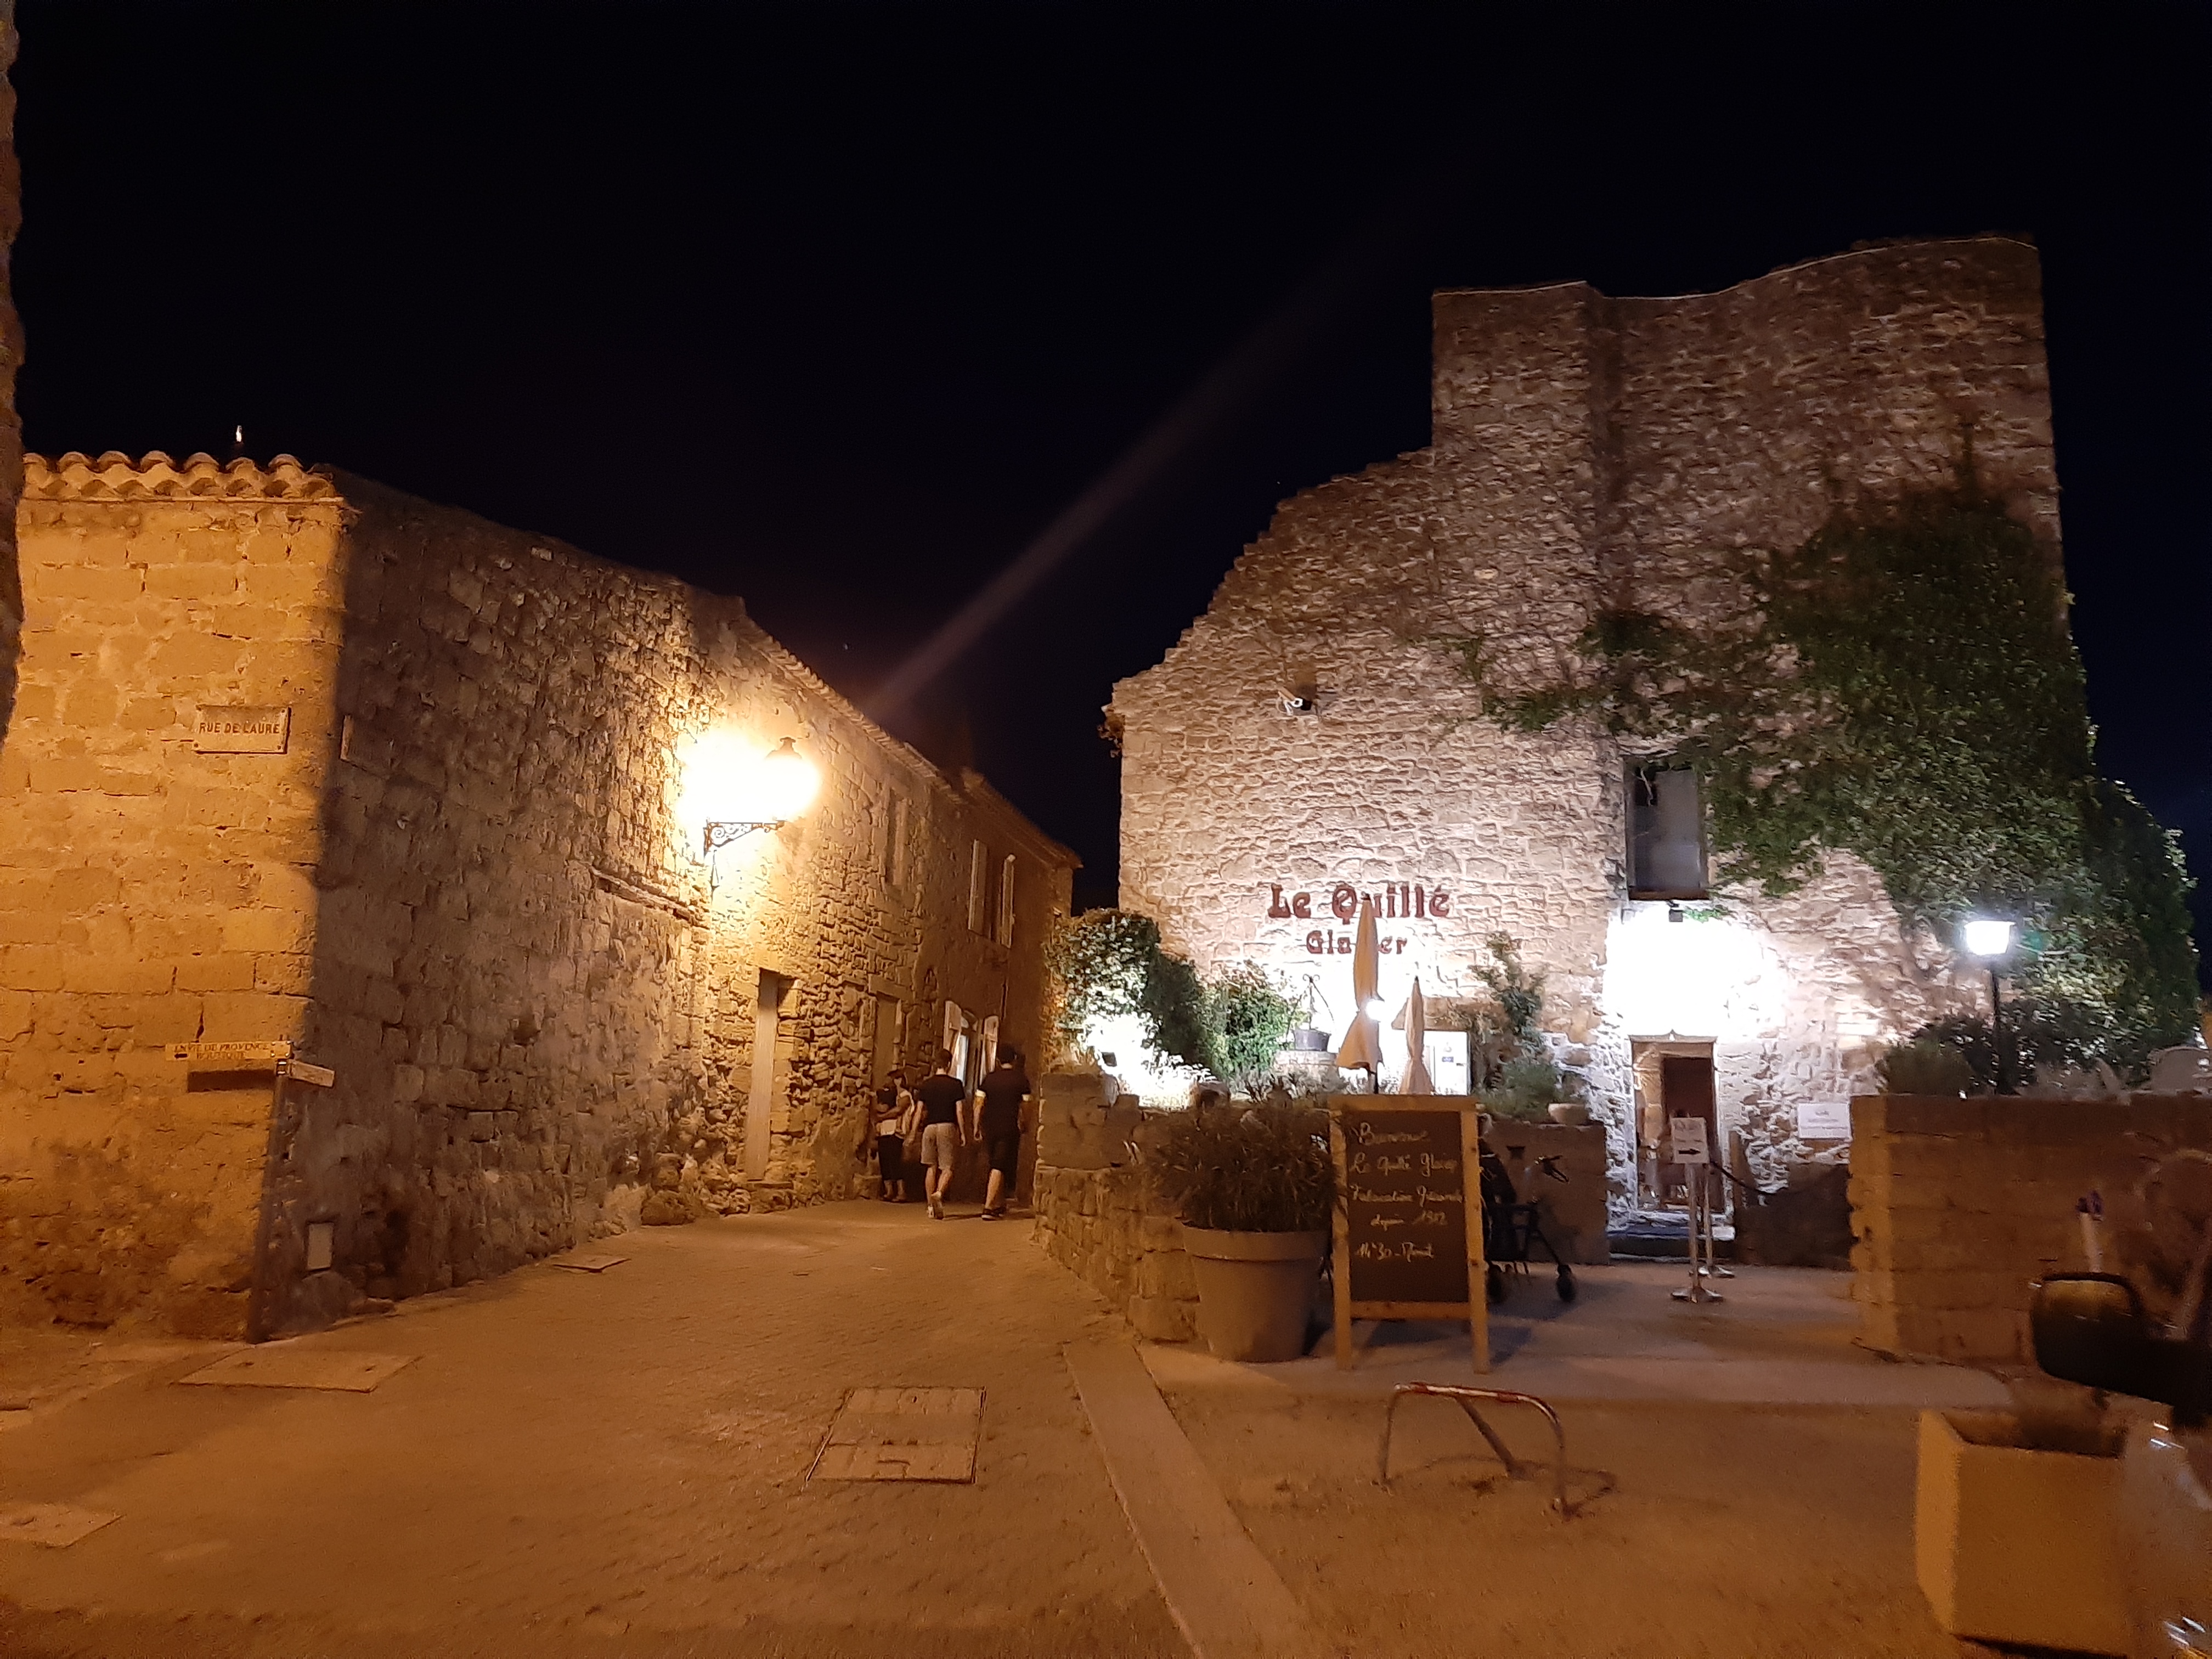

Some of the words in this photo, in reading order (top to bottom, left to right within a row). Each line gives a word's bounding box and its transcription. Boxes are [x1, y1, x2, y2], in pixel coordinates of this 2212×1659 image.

[199, 722, 221, 733] RUE
[224, 723, 241, 733] DE
[1267, 883, 1311, 918] Le
[1306, 929, 1408, 955] Glaer
